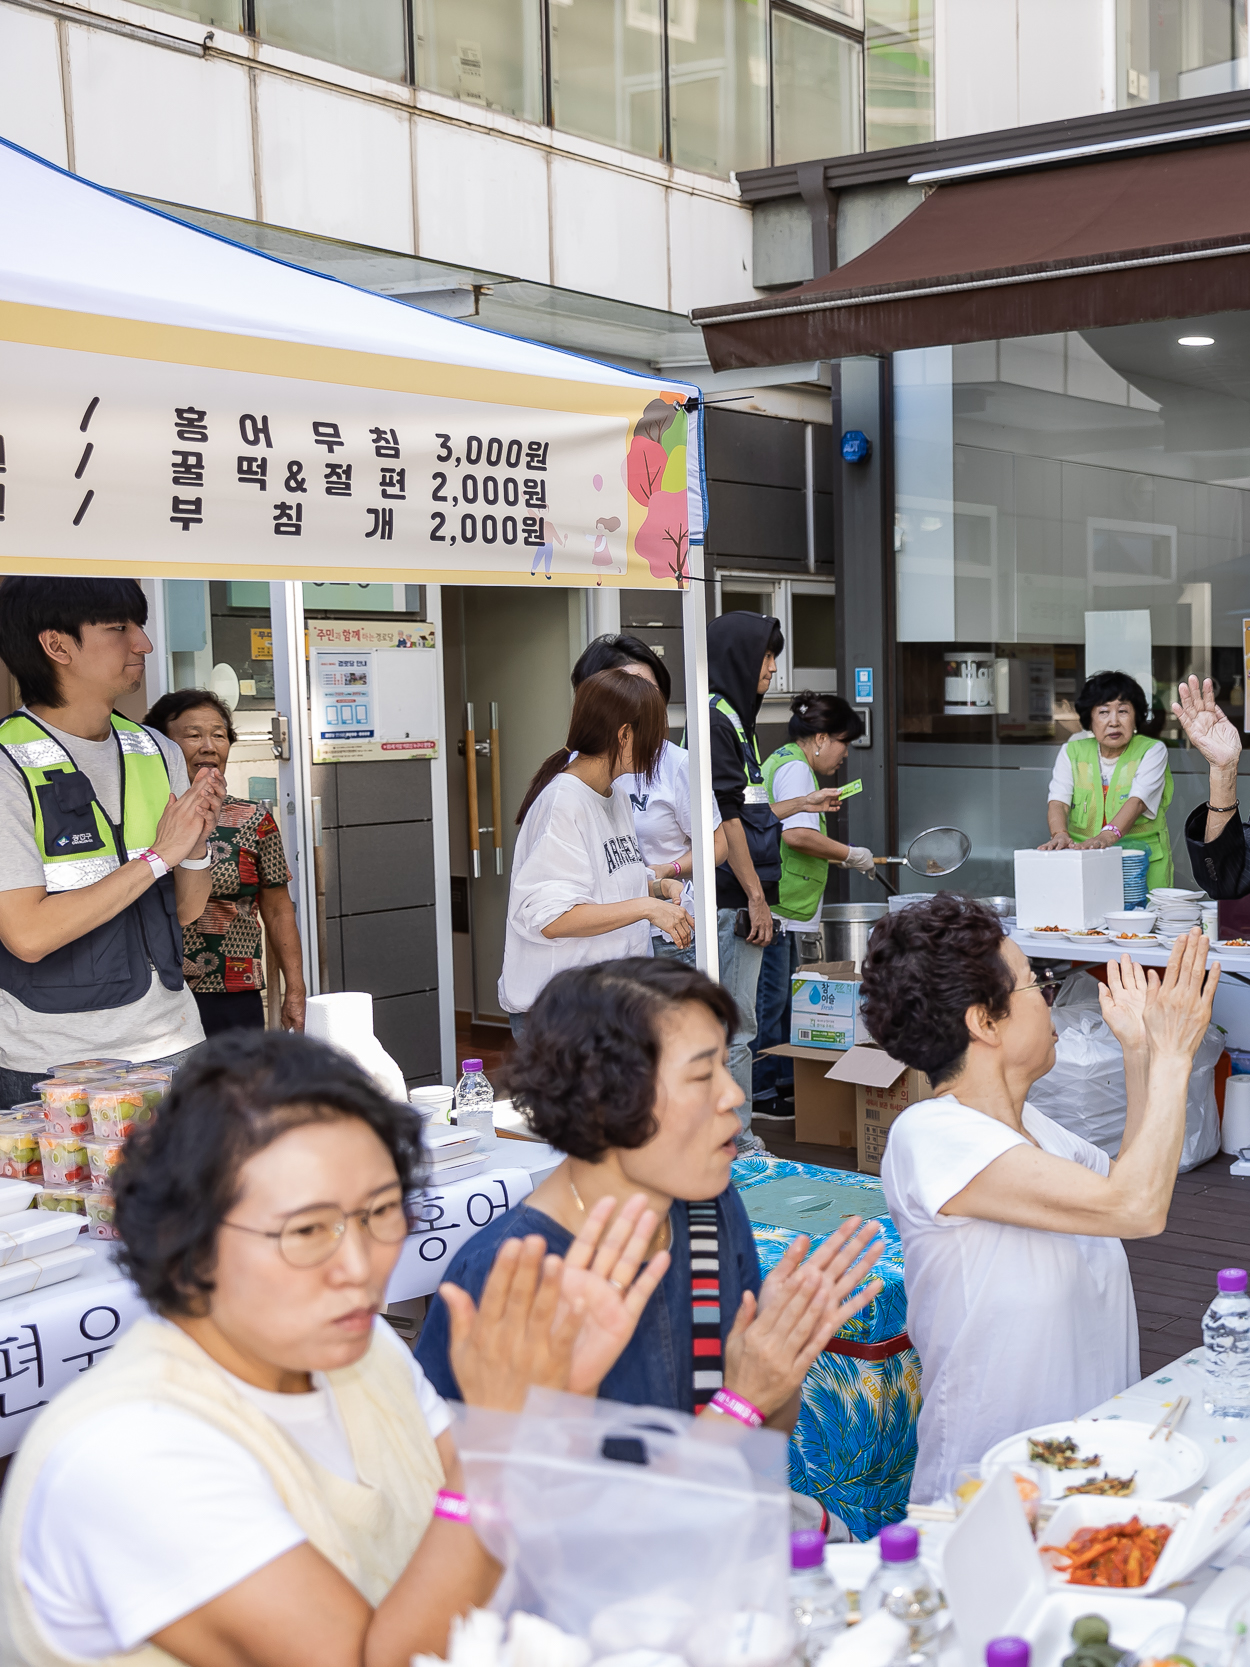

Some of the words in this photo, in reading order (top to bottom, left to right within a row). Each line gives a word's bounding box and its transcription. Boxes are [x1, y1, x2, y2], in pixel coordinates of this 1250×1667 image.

[435, 433, 550, 471] 3,000원
[431, 471, 547, 509] 2,000원
[429, 511, 546, 547] 2,000원
